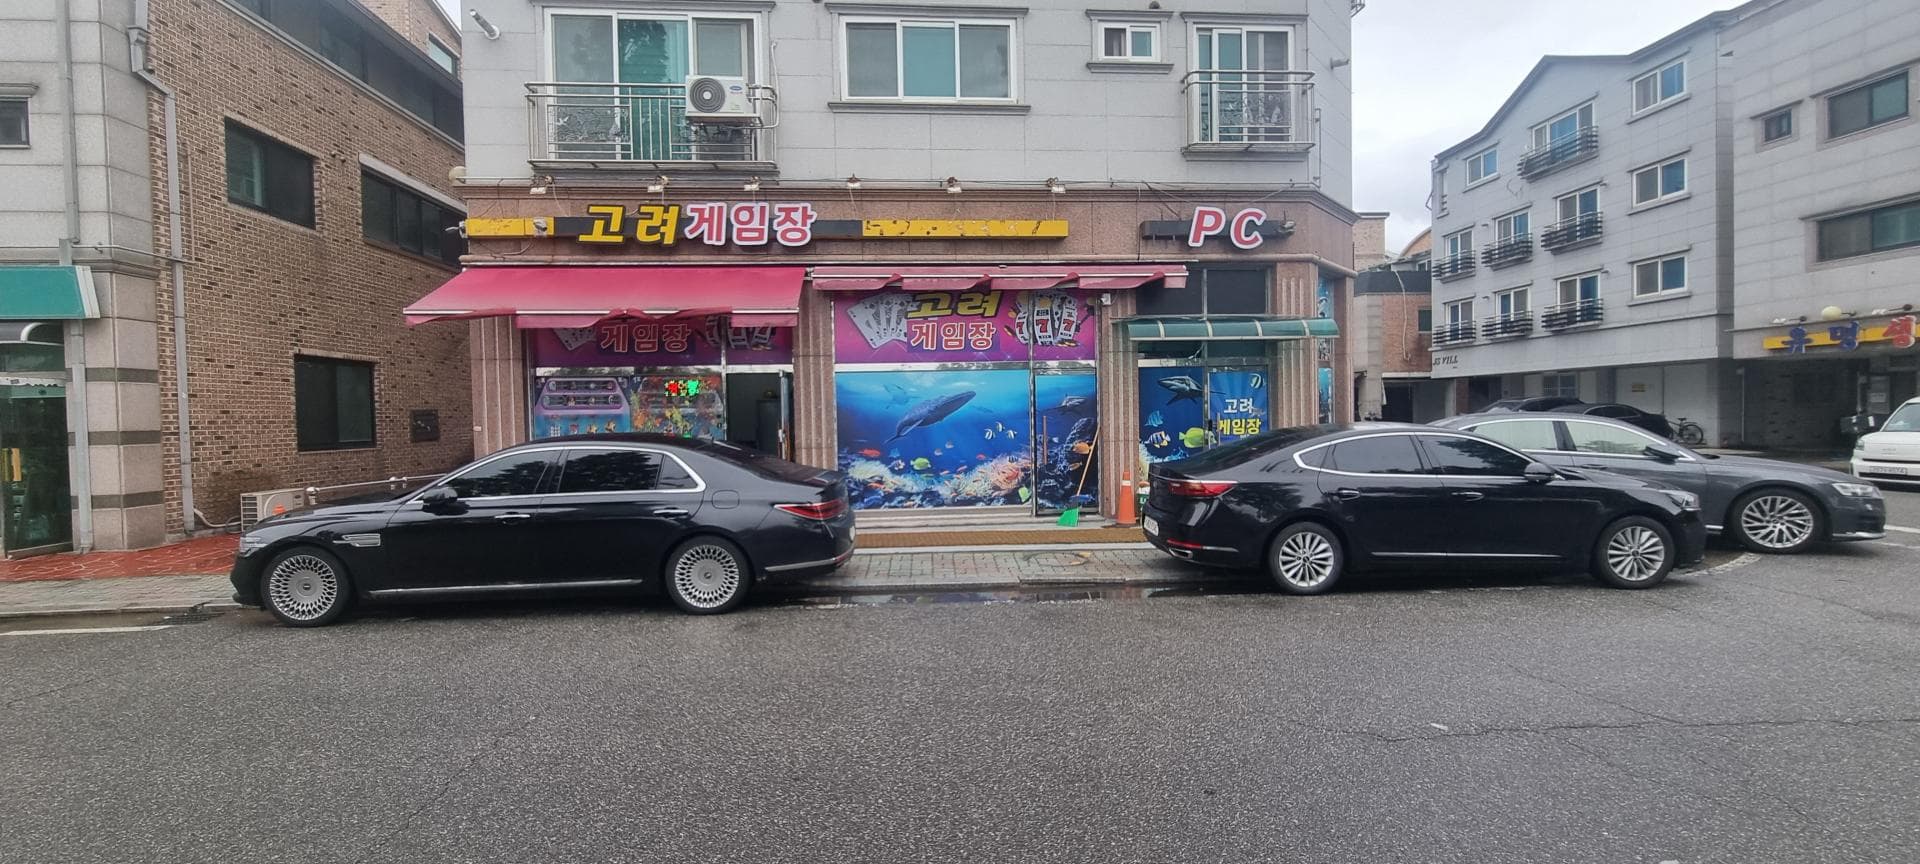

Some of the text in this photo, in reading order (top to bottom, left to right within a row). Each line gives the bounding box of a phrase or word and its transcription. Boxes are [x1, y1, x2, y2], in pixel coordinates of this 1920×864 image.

[577, 202, 817, 247] 고려 게임장
[1188, 206, 1267, 249] PC
[905, 290, 1002, 319] 고려
[600, 323, 692, 353] 게임장
[911, 321, 997, 351] 게임장
[1223, 398, 1254, 414] 고려
